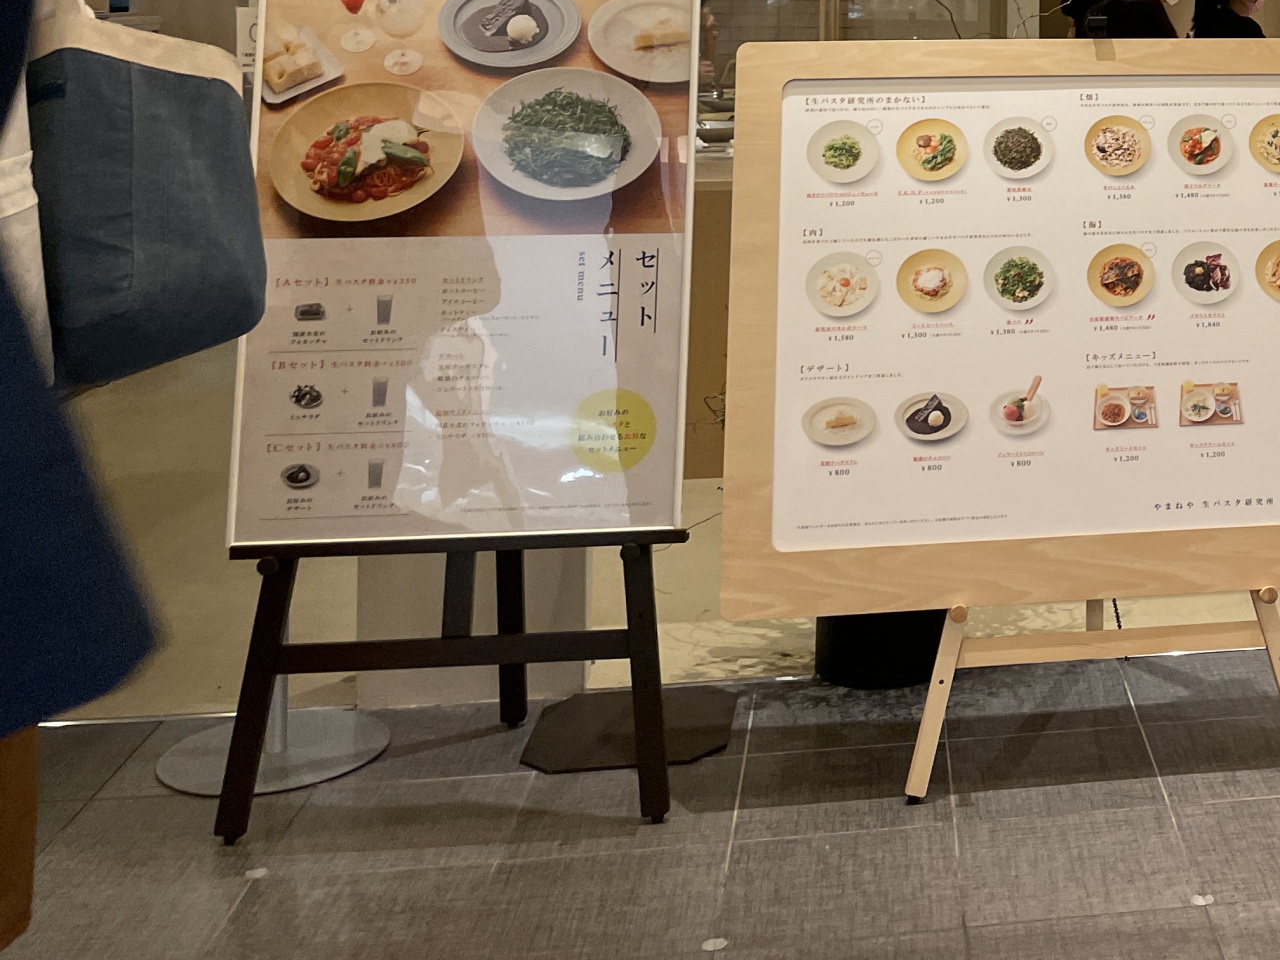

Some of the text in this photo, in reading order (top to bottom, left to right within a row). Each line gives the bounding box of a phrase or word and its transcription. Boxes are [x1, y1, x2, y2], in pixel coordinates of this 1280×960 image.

[597, 250, 618, 356] メニュー
[636, 250, 656, 327] セット
[1154, 501, 1194, 510] やまねや
[1202, 498, 1274, 508] 生パスタ研究所
